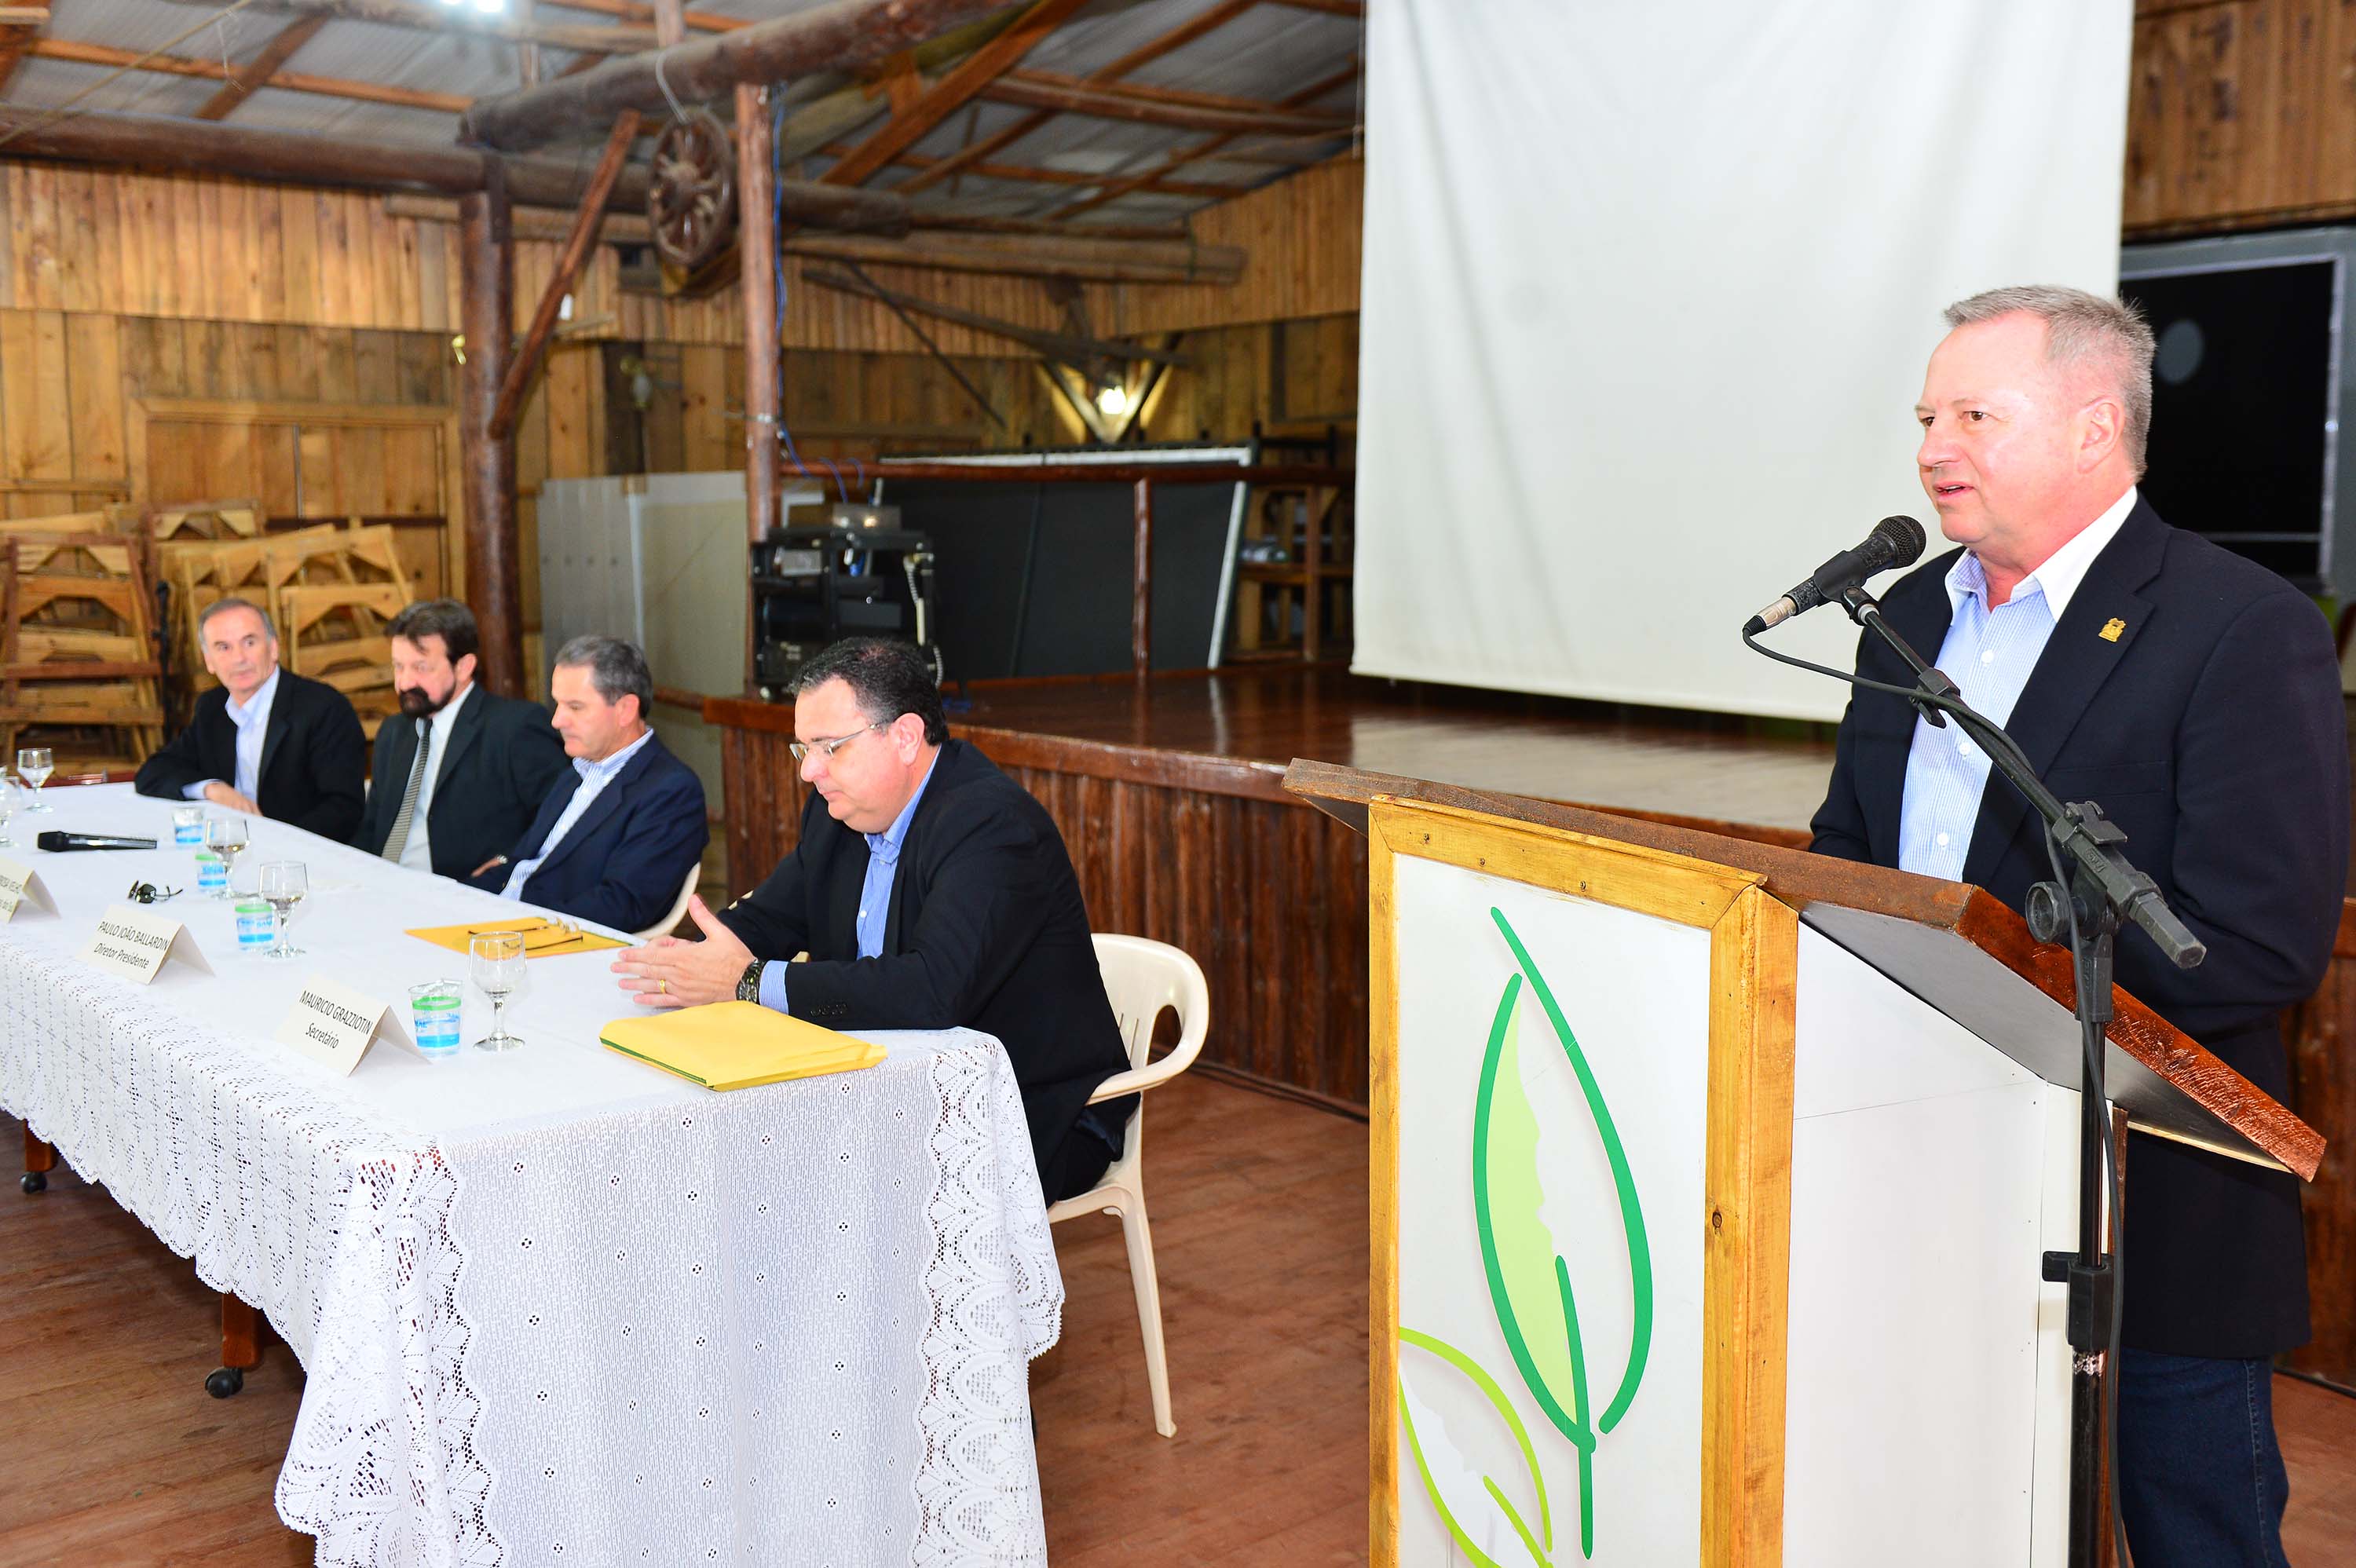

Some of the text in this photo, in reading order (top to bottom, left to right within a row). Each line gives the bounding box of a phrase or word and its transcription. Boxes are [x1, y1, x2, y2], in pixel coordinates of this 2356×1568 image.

[97, 921, 169, 951] PAULO JOÃO BALLARDIN
[94, 943, 149, 968] Diretor Presidente
[299, 990, 373, 1035] MAURICIO GRAZZIOTIN
[305, 1022, 339, 1049] Secretário
